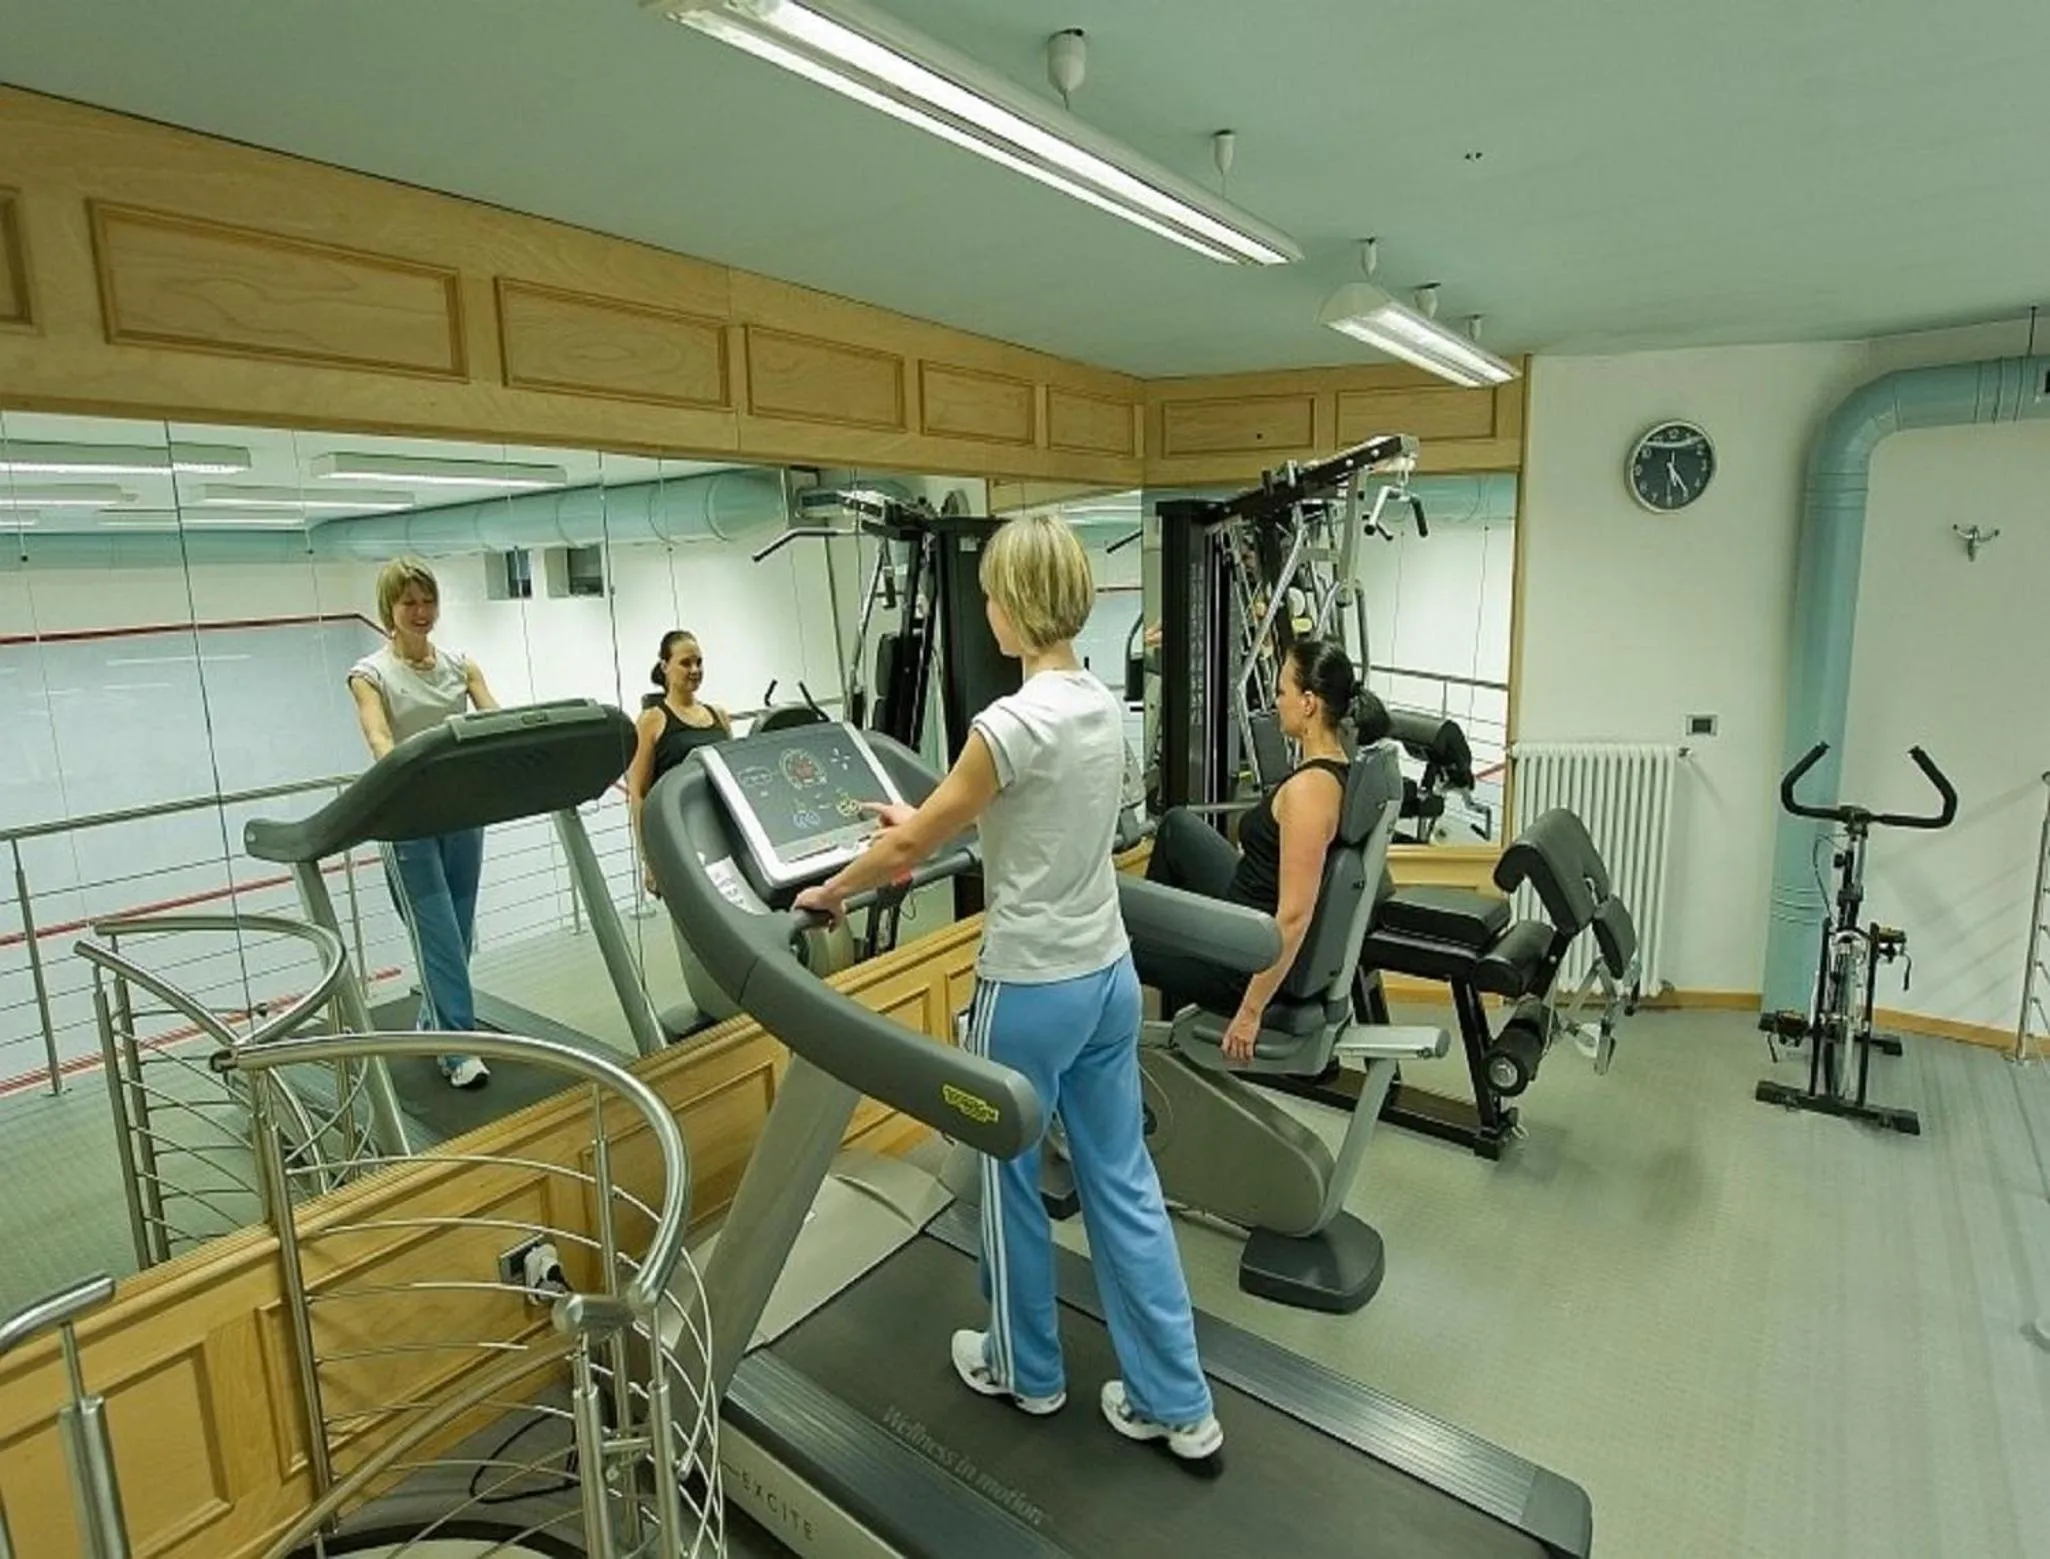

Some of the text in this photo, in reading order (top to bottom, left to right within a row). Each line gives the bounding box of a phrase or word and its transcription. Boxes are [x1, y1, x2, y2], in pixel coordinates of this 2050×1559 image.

[742, 1471, 815, 1542] EXCITE
[954, 1453, 978, 1482] in
[975, 1473, 1045, 1527] motion
